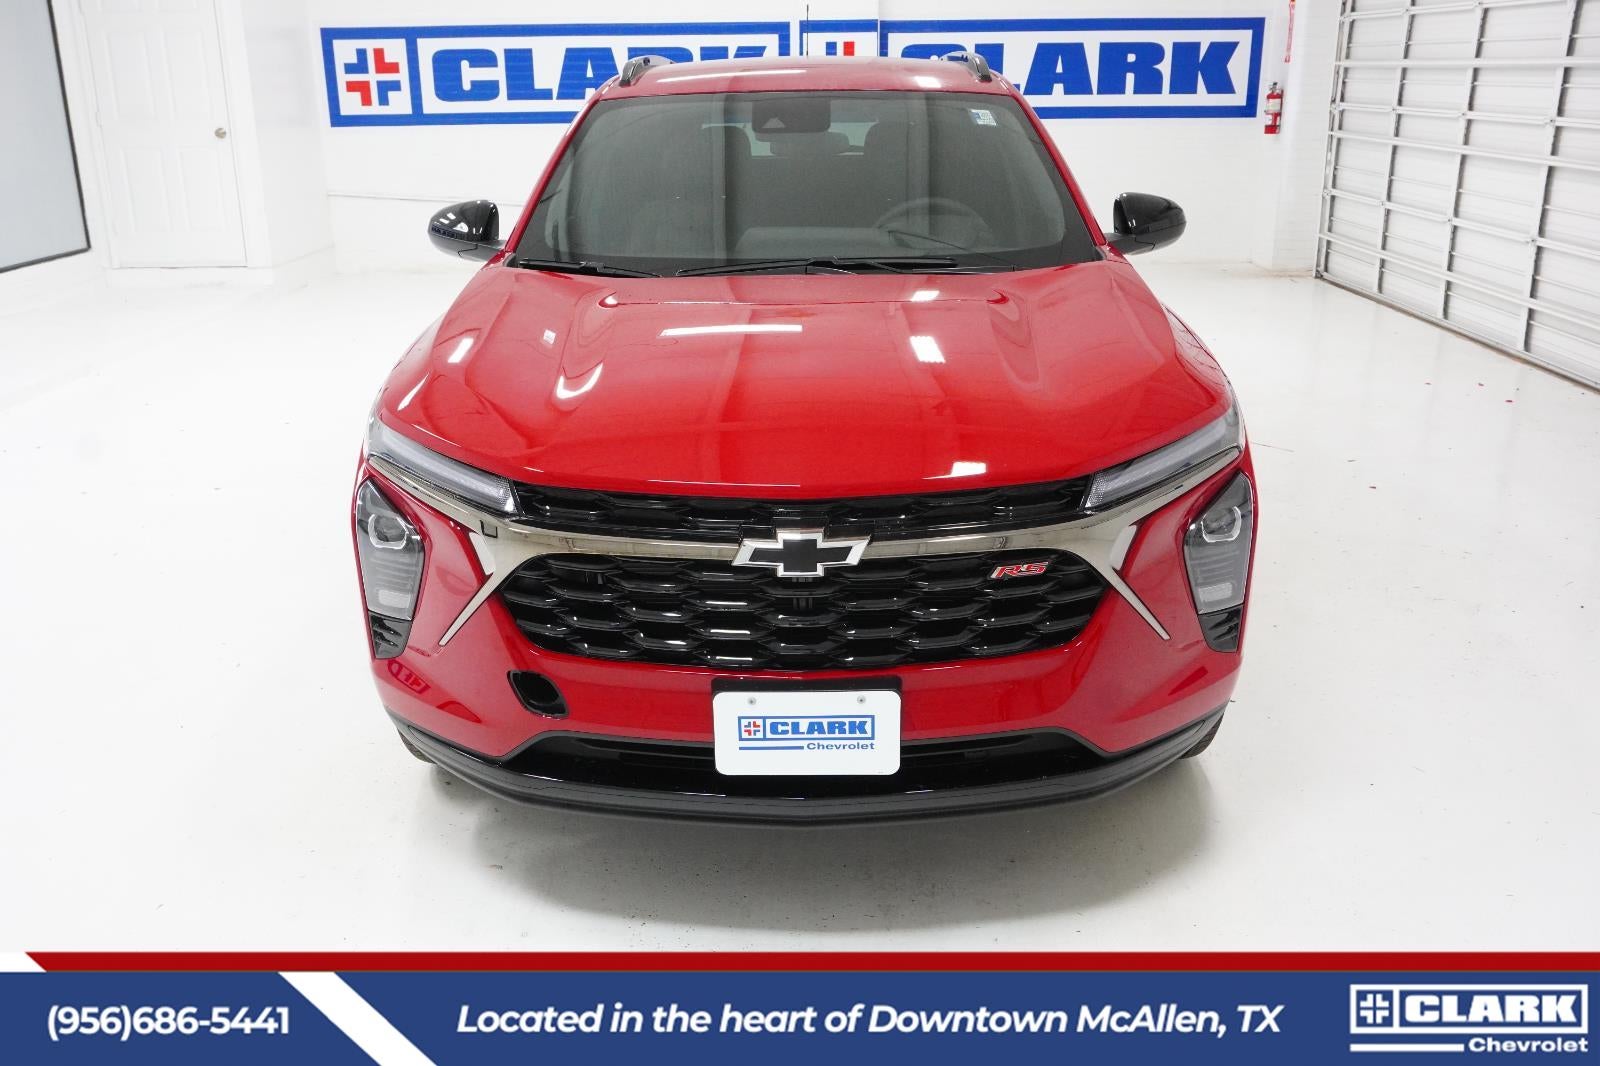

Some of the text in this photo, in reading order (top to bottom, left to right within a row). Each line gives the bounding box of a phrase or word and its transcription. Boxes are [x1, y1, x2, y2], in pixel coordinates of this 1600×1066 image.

[431, 45, 767, 102] CLA
[990, 562, 1049, 579] RS
[769, 720, 868, 736] CLARK
[806, 742, 875, 751] Chevrolet
